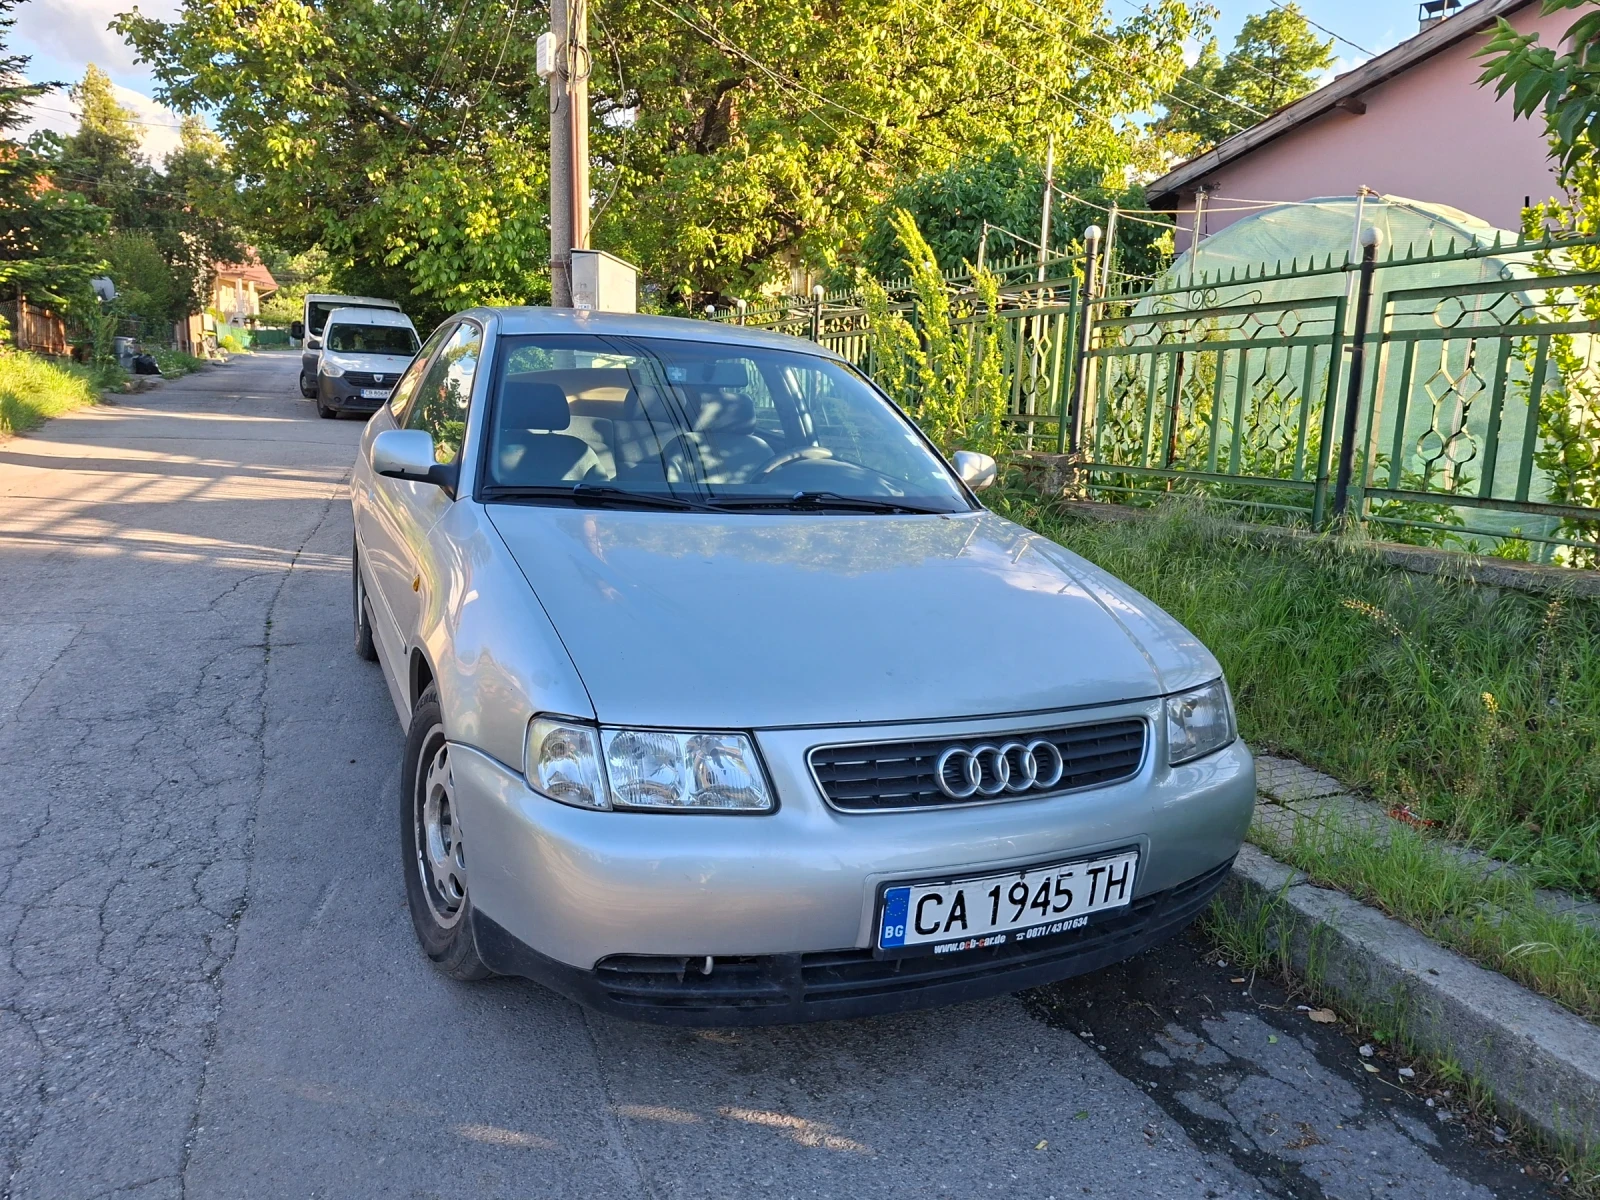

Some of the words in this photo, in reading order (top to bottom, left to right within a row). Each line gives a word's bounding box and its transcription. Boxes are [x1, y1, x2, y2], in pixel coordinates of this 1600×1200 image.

[914, 890, 968, 936] CA
[988, 872, 1074, 926] 1945
[1087, 861, 1130, 907] TH
[884, 925, 904, 939] BG
